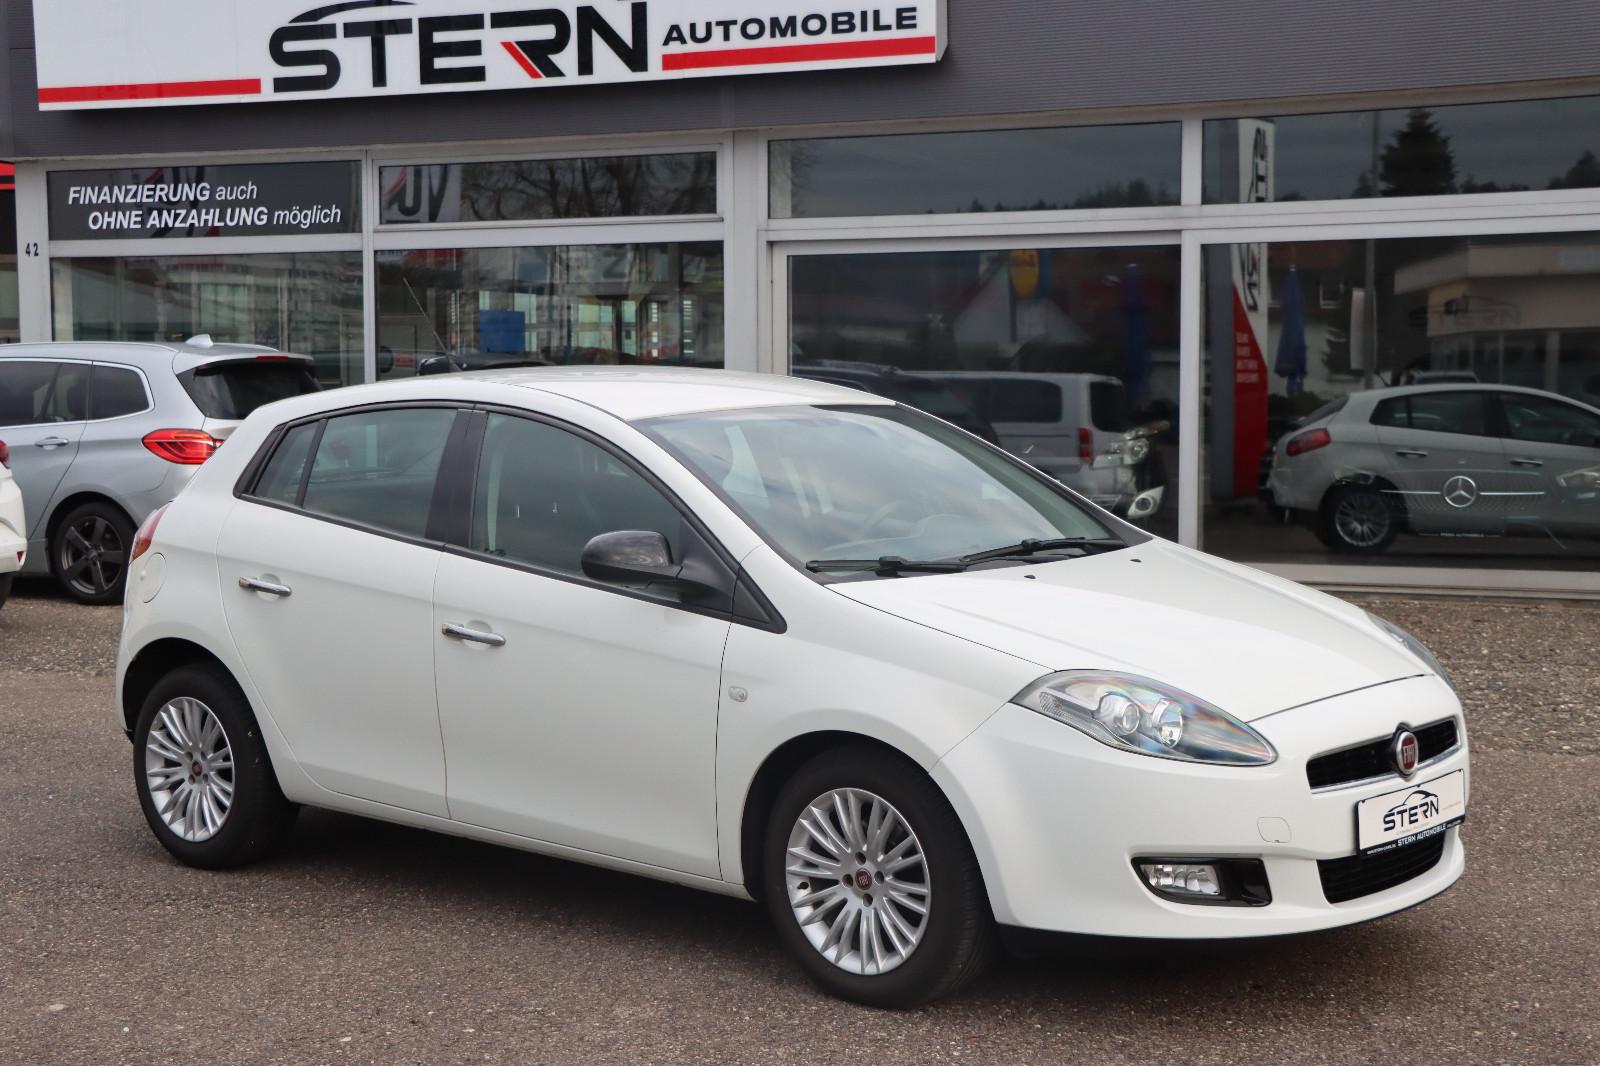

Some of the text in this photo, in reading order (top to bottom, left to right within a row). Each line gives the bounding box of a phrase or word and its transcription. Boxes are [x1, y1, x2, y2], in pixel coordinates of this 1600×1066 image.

[269, 2, 917, 92] STERN AUTOMOBILE
[68, 181, 258, 205] FINANZIERUNG auch
[88, 204, 341, 230] OHNE ANZAHLUNG möglich
[25, 242, 39, 257] 42
[1383, 798, 1439, 832] STERN
[1397, 834, 1416, 847] STERN
[1416, 823, 1447, 841] AUTOMOBILE
